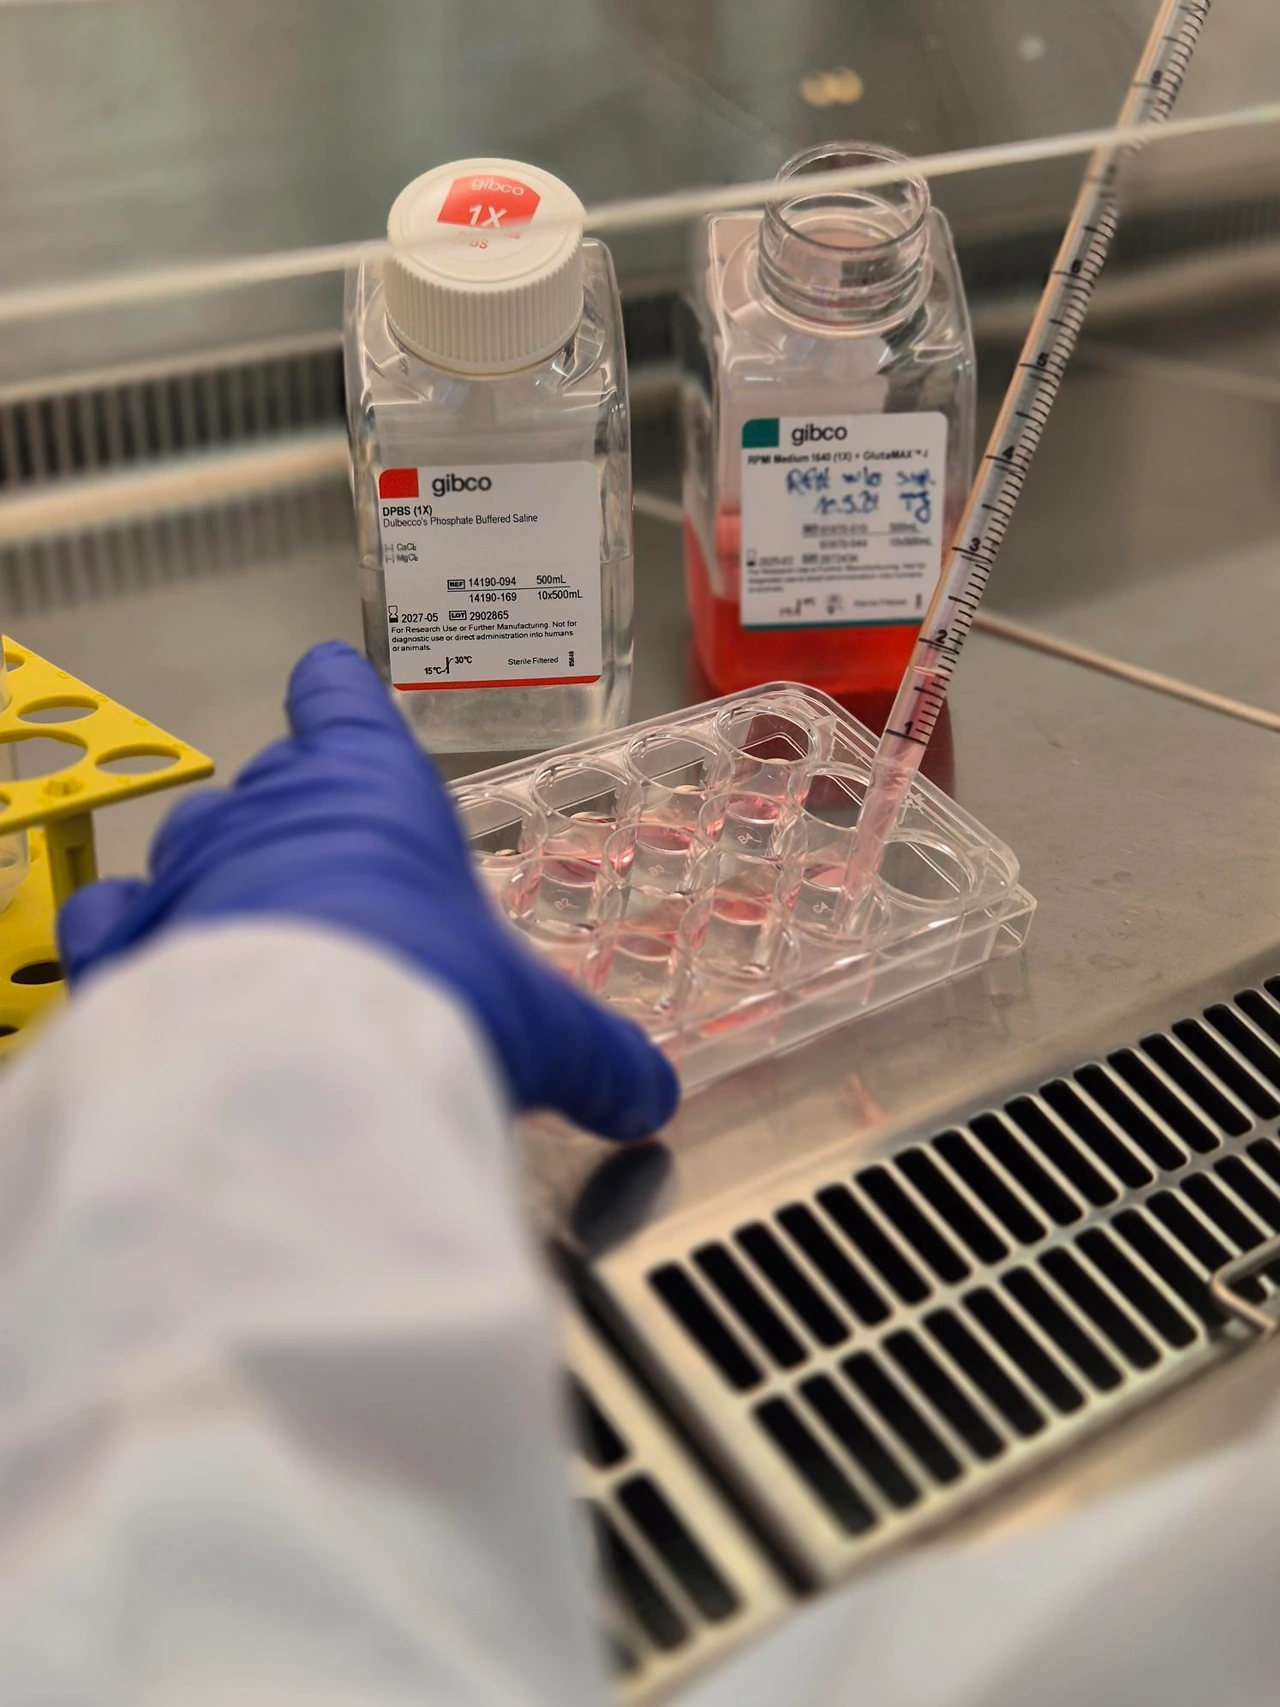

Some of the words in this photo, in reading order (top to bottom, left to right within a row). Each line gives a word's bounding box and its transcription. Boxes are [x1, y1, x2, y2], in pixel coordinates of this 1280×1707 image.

[471, 178, 525, 196] gibco
[469, 204, 508, 228] 1X
[1071, 259, 1082, 274] 6
[1037, 352, 1048, 367] 5
[791, 424, 848, 447] gibco
[748, 455, 772, 465] RPMI
[774, 454, 809, 464] Medium
[812, 452, 831, 462] 1640
[834, 452, 852, 463] (1X)
[1002, 445, 1015, 460] 4
[432, 473, 492, 497] gibco
[382, 506, 411, 517] DPBS
[414, 505, 433, 516] (1X)
[383, 517, 428, 528] Dulbecco's
[430, 516, 473, 528] Phosphate
[475, 514, 511, 524] Buffered
[513, 513, 538, 523] Saline
[969, 537, 981, 552] 3
[469, 577, 516, 587] 14190-094
[536, 575, 566, 585] 500mL
[469, 593, 517, 603] 14190-169
[537, 590, 583, 600] 10x500mL
[401, 613, 438, 623] 2027-05
[450, 611, 466, 620] LOT
[470, 610, 509, 621] 2902865
[391, 626, 403, 634] For
[405, 624, 441, 633] Research
[442, 624, 458, 632] Use
[469, 623, 495, 631] Further
[552, 620, 565, 628] Not
[392, 634, 430, 644] diagnostic
[455, 632, 475, 641] direct
[476, 631, 528, 640] administration
[529, 630, 543, 638] into
[544, 629, 574, 637] humans
[935, 629, 948, 644] 2
[508, 658, 531, 666] Sterile
[532, 657, 558, 665] Filtered
[904, 721, 914, 735] 1
[737, 833, 752, 845] B4
